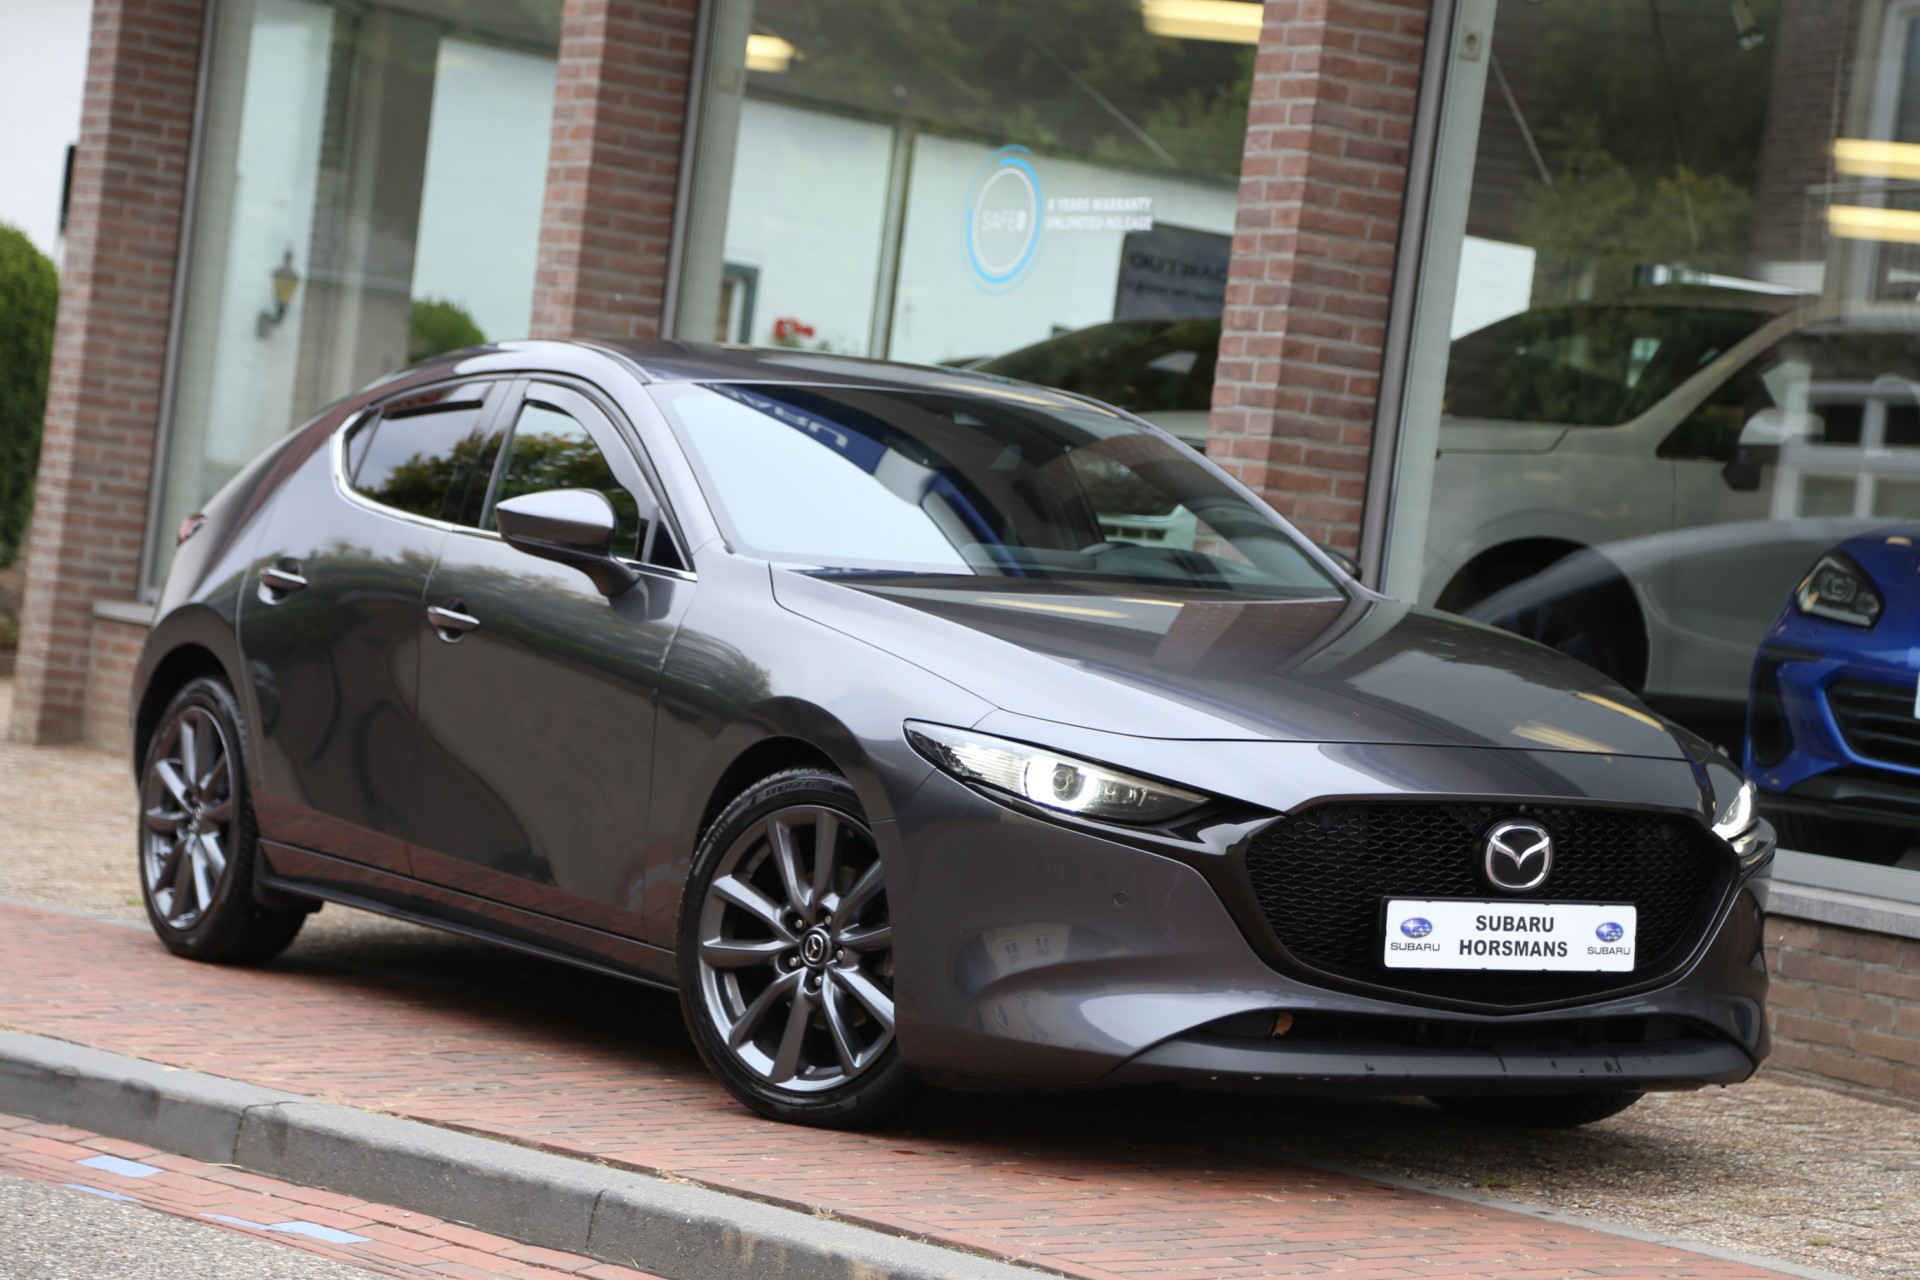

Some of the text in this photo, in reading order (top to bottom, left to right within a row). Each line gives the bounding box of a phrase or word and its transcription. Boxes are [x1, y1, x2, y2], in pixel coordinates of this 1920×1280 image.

[1057, 198, 1089, 211] YEARS
[1092, 197, 1152, 211] WARRANTY
[1046, 215, 1152, 230] UNLIMITED MILEAGE
[1475, 914, 1555, 933] SUBARU
[1390, 941, 1441, 952] SUBARU
[1458, 939, 1569, 958] HORSMANS
[1586, 946, 1631, 956] SUBARU
